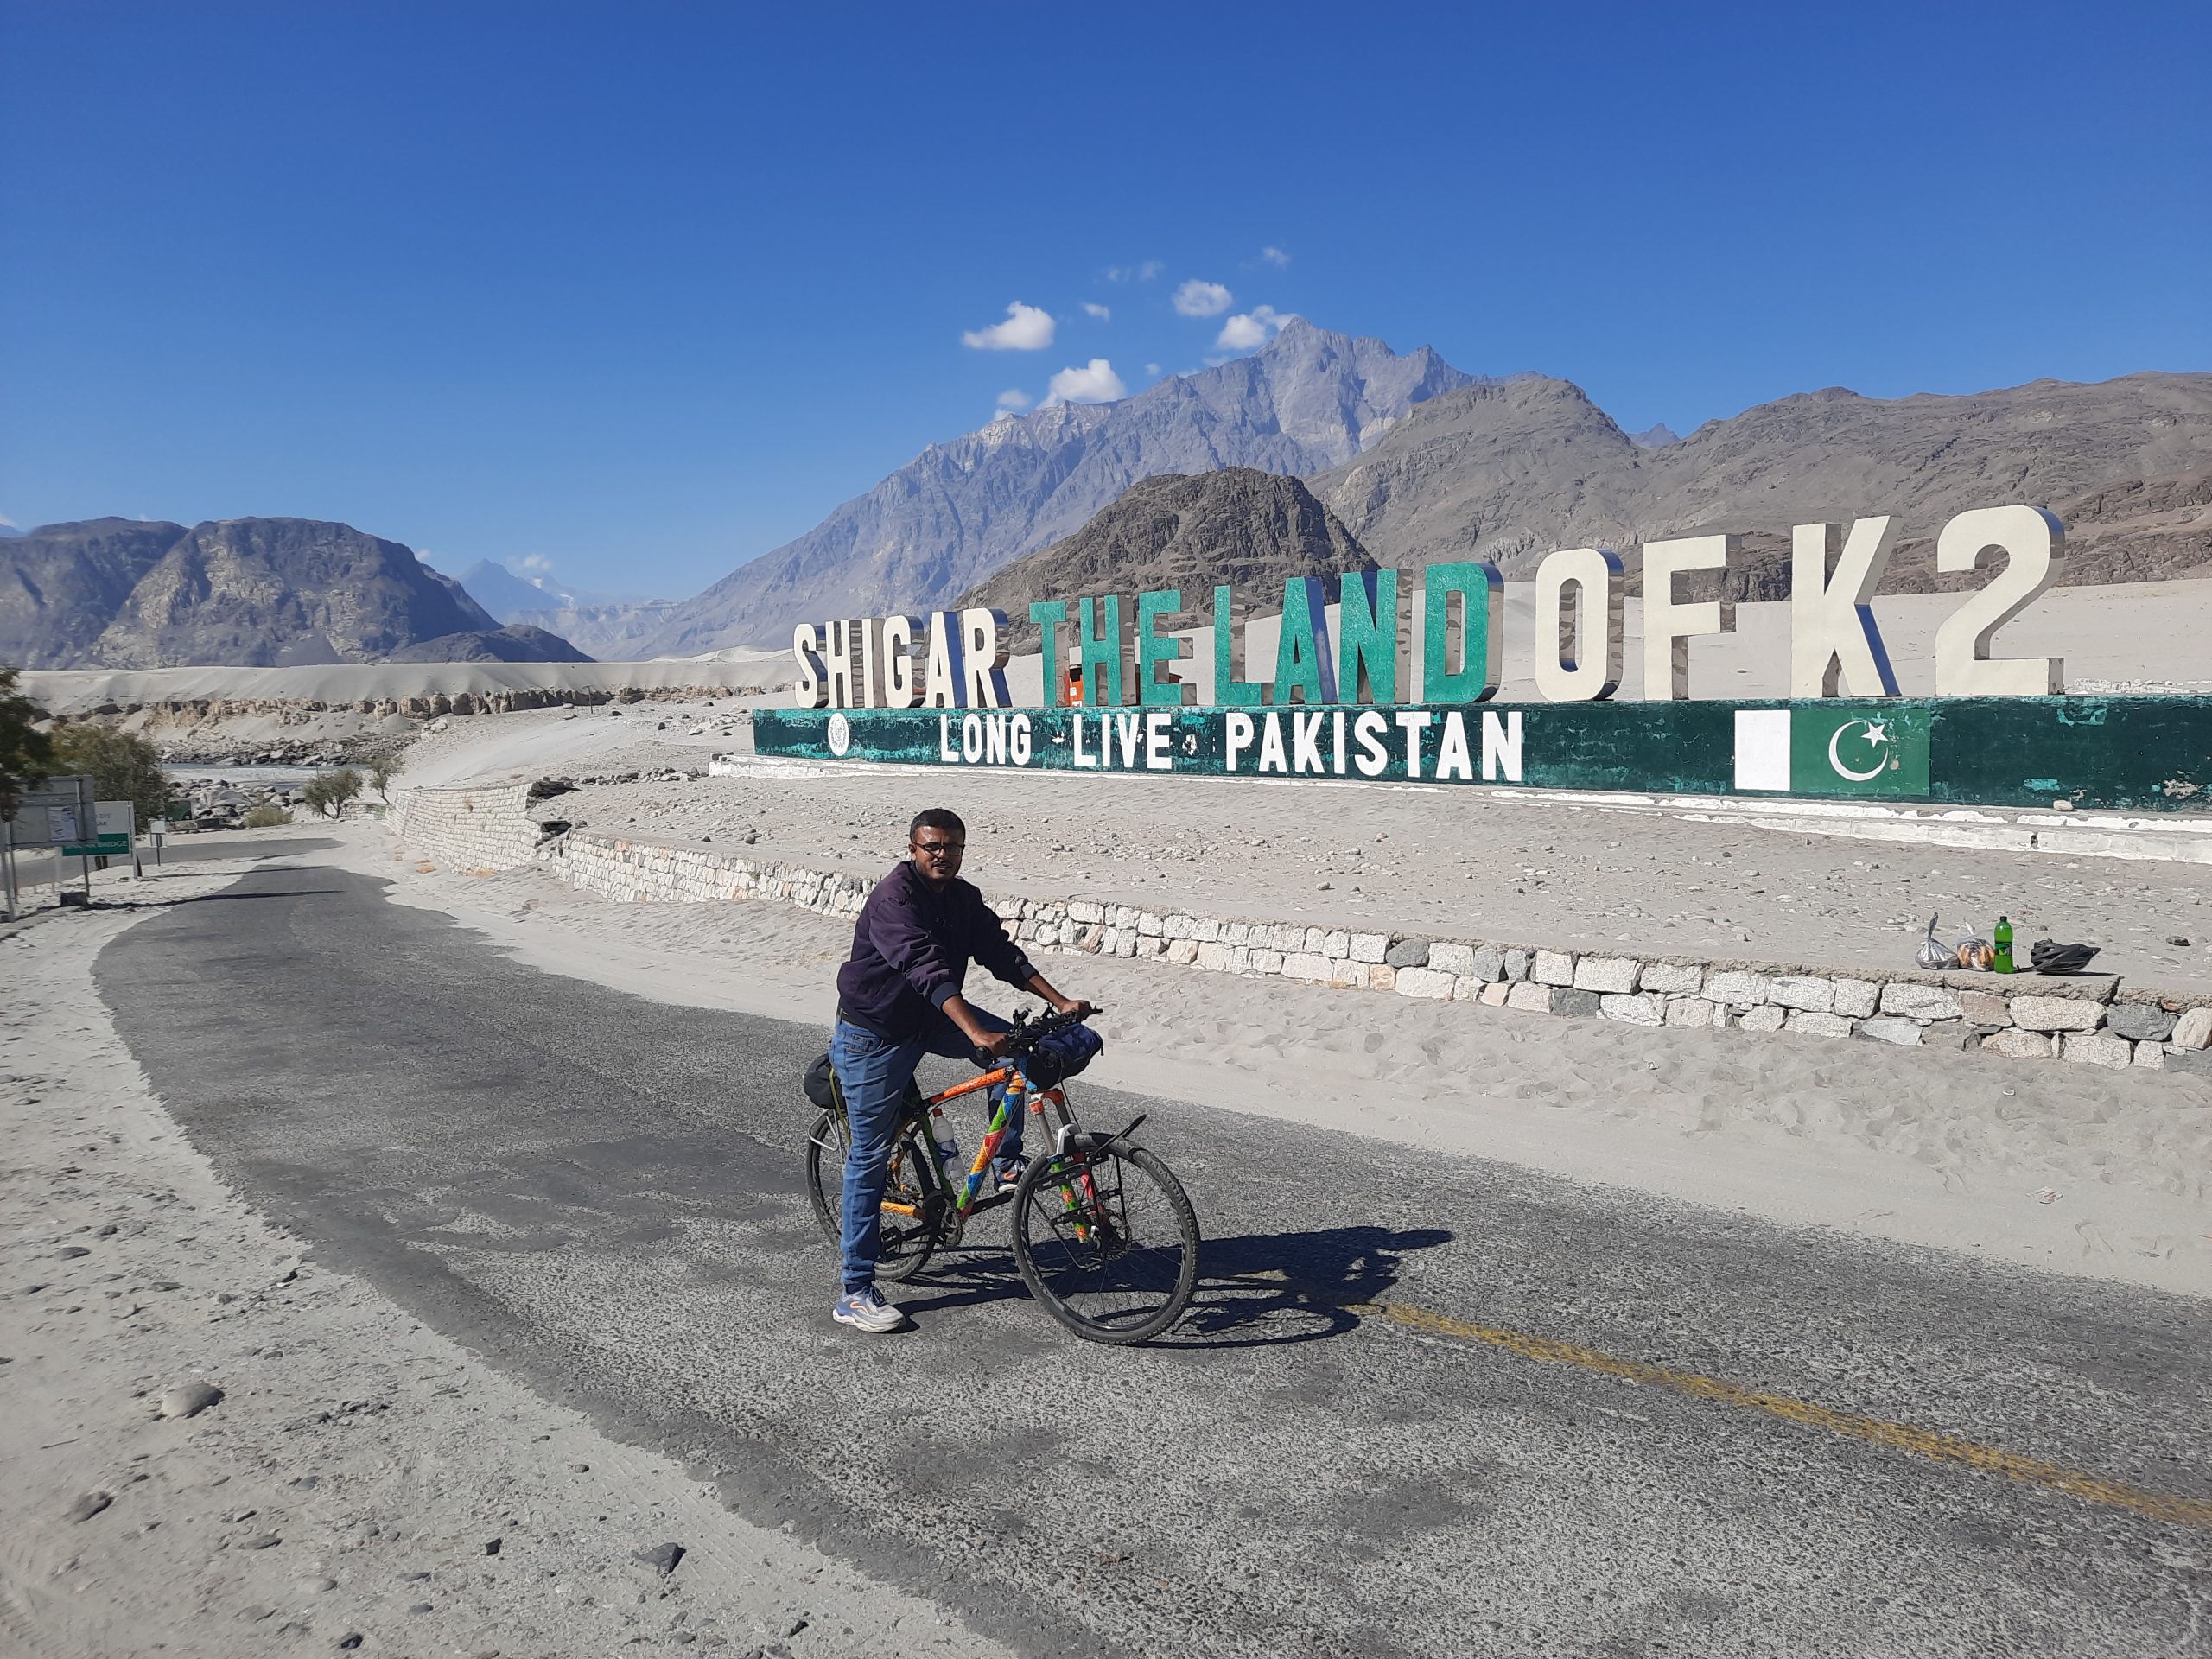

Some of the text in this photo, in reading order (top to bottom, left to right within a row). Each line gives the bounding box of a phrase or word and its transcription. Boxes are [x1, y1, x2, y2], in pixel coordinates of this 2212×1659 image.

[794, 607, 1002, 708] SHIGAR
[1029, 589, 1184, 707] THE
[1214, 562, 1493, 706] LAND
[1535, 534, 1731, 701] OF
[940, 711, 1522, 782] LONG LIVE PAKISTAN
